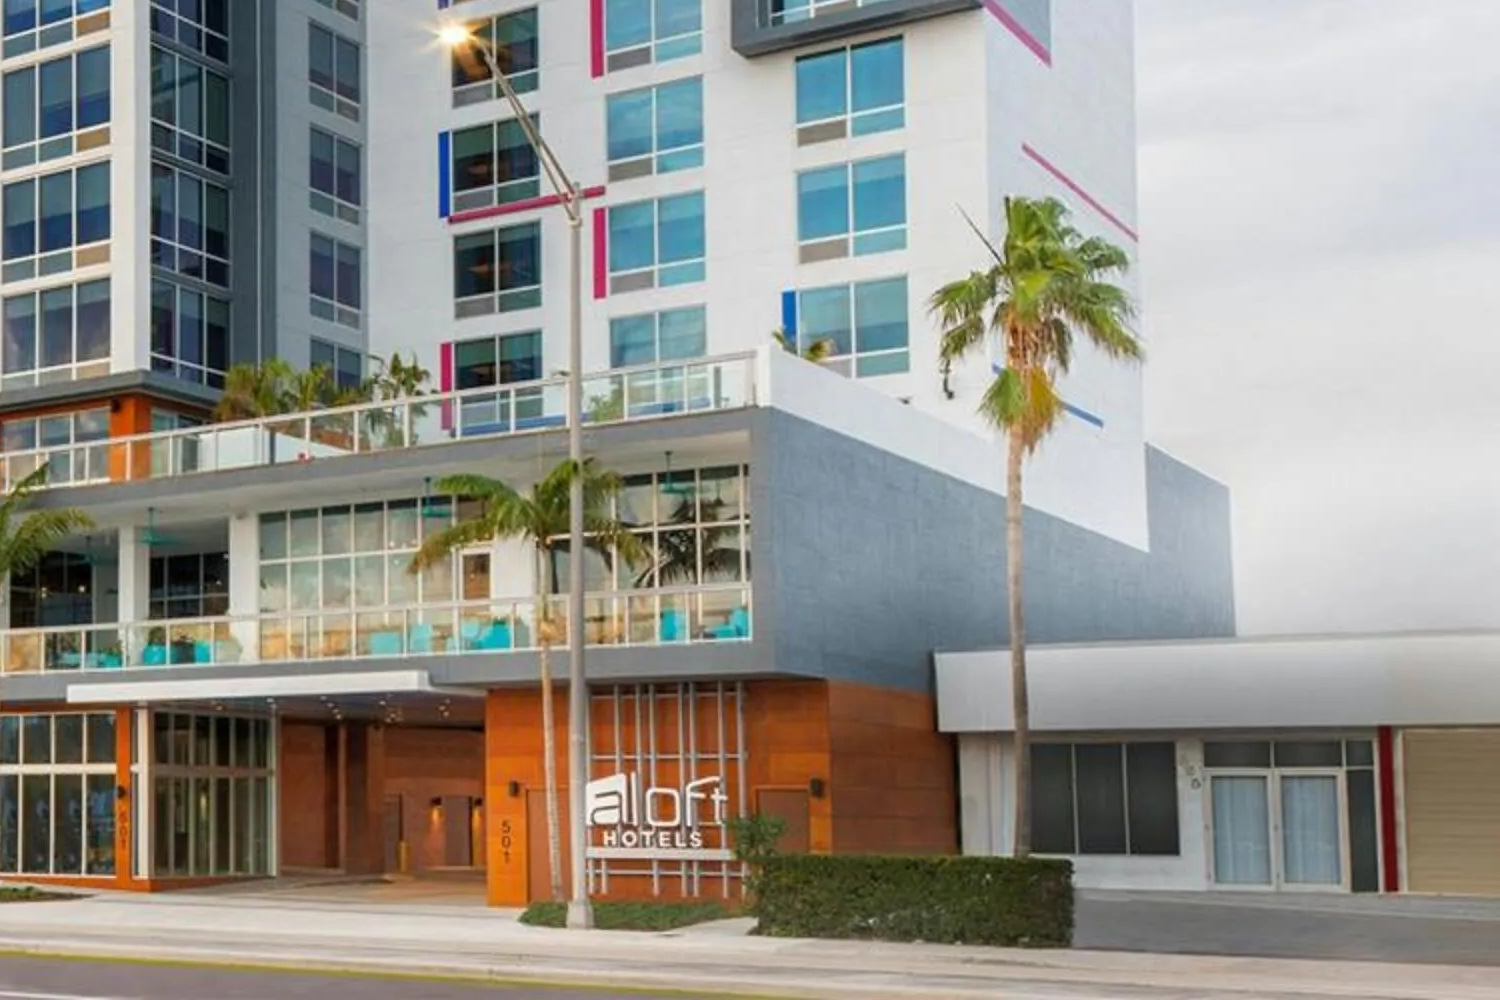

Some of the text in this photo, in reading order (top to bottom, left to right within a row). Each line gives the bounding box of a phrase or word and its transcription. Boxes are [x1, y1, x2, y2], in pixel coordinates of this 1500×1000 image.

[586, 772, 728, 827] aloft
[501, 819, 511, 864] 501
[603, 830, 703, 848] HOTELS
